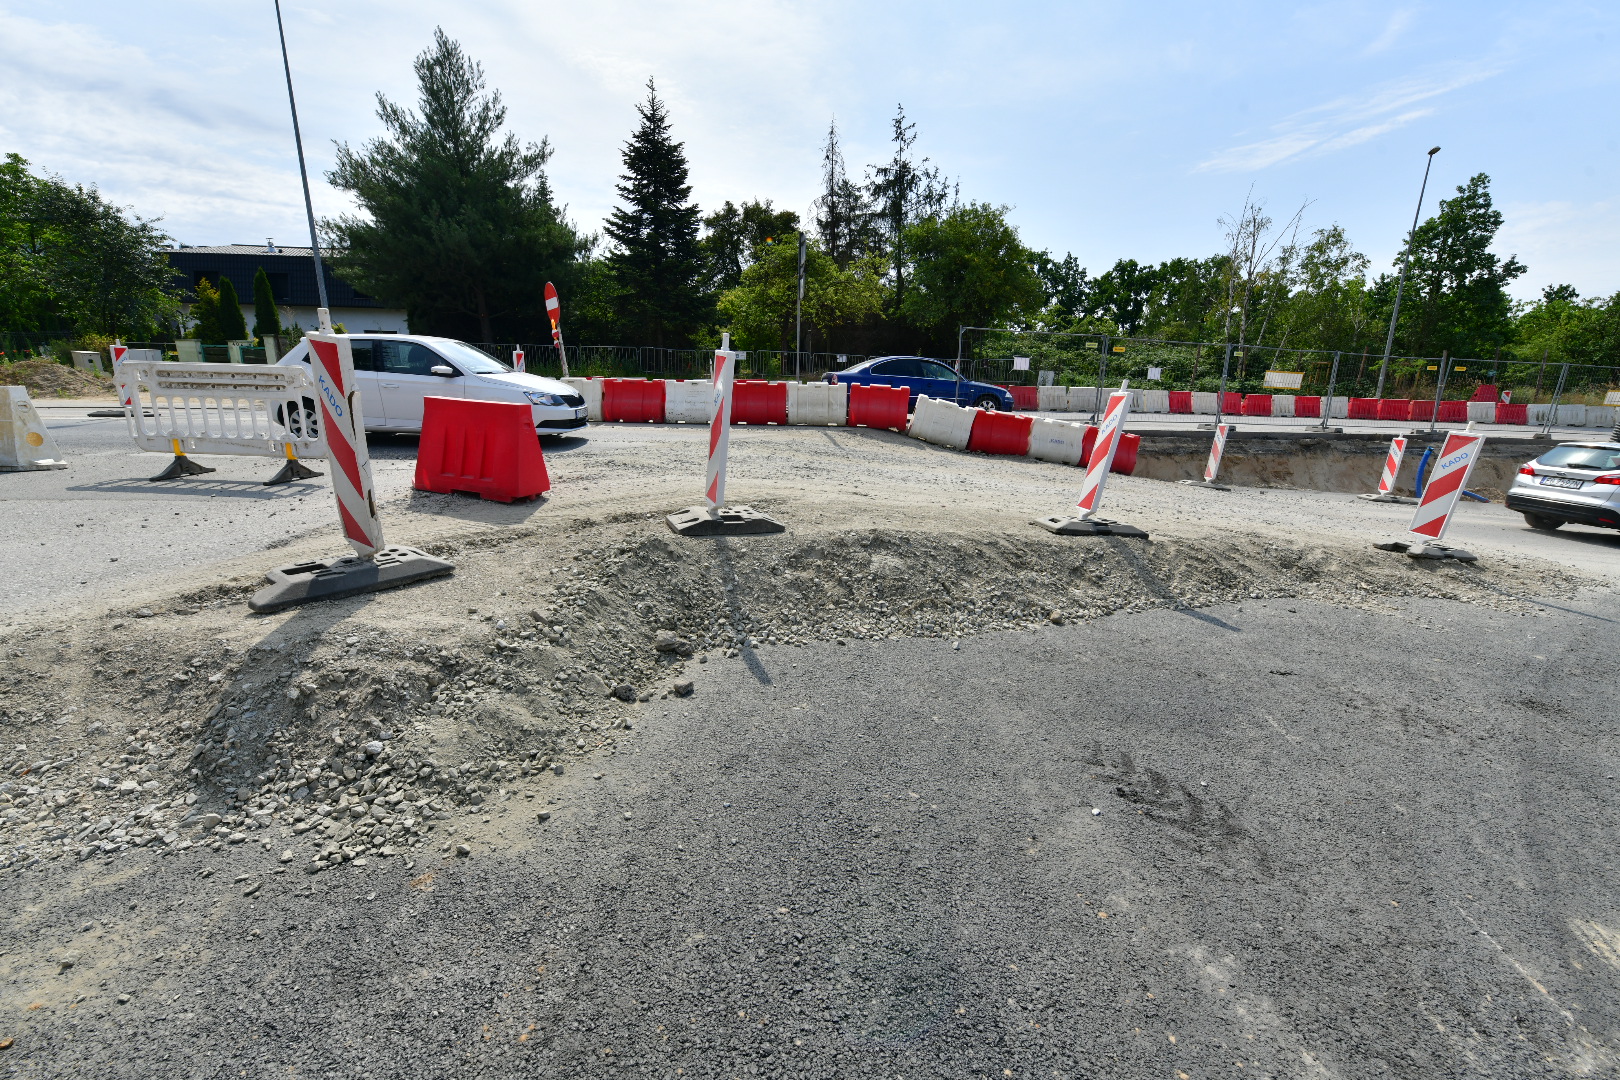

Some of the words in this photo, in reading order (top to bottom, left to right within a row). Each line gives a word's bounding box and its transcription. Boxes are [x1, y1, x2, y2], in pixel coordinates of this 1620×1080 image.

[318, 374, 343, 417] KADO
[1101, 414, 1118, 435] KADO
[1441, 452, 1469, 470] KADO
